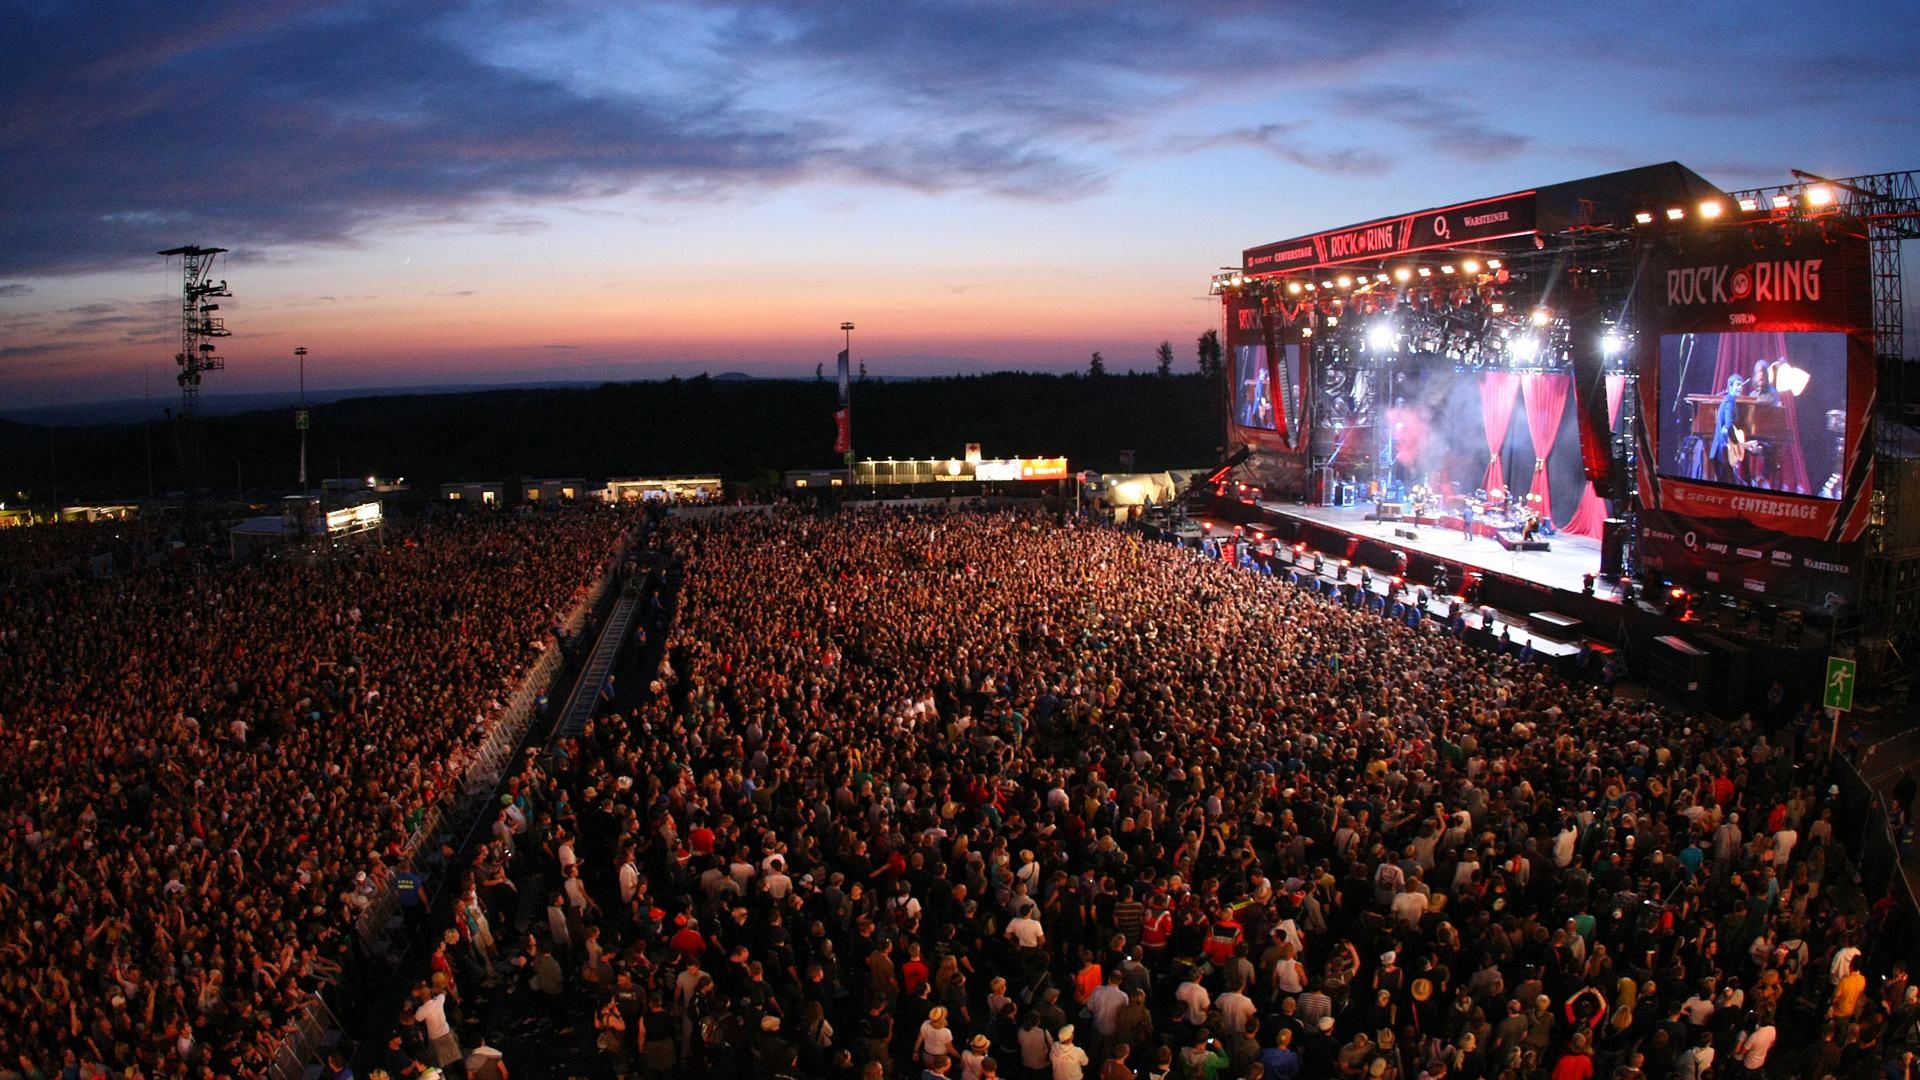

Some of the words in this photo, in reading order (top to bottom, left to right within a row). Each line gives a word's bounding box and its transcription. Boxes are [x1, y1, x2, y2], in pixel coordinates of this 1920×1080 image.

[1464, 211, 1509, 227] WARSTEINER
[1331, 232, 1358, 258] ROCK
[1367, 225, 1393, 251] RING
[1667, 265, 1729, 306] ROCK
[1755, 260, 1822, 301] RING
[1688, 492, 1727, 504] SEAT
[1731, 496, 1818, 520] CENTERSTAGE
[1804, 558, 1849, 574] WARSTEINER
